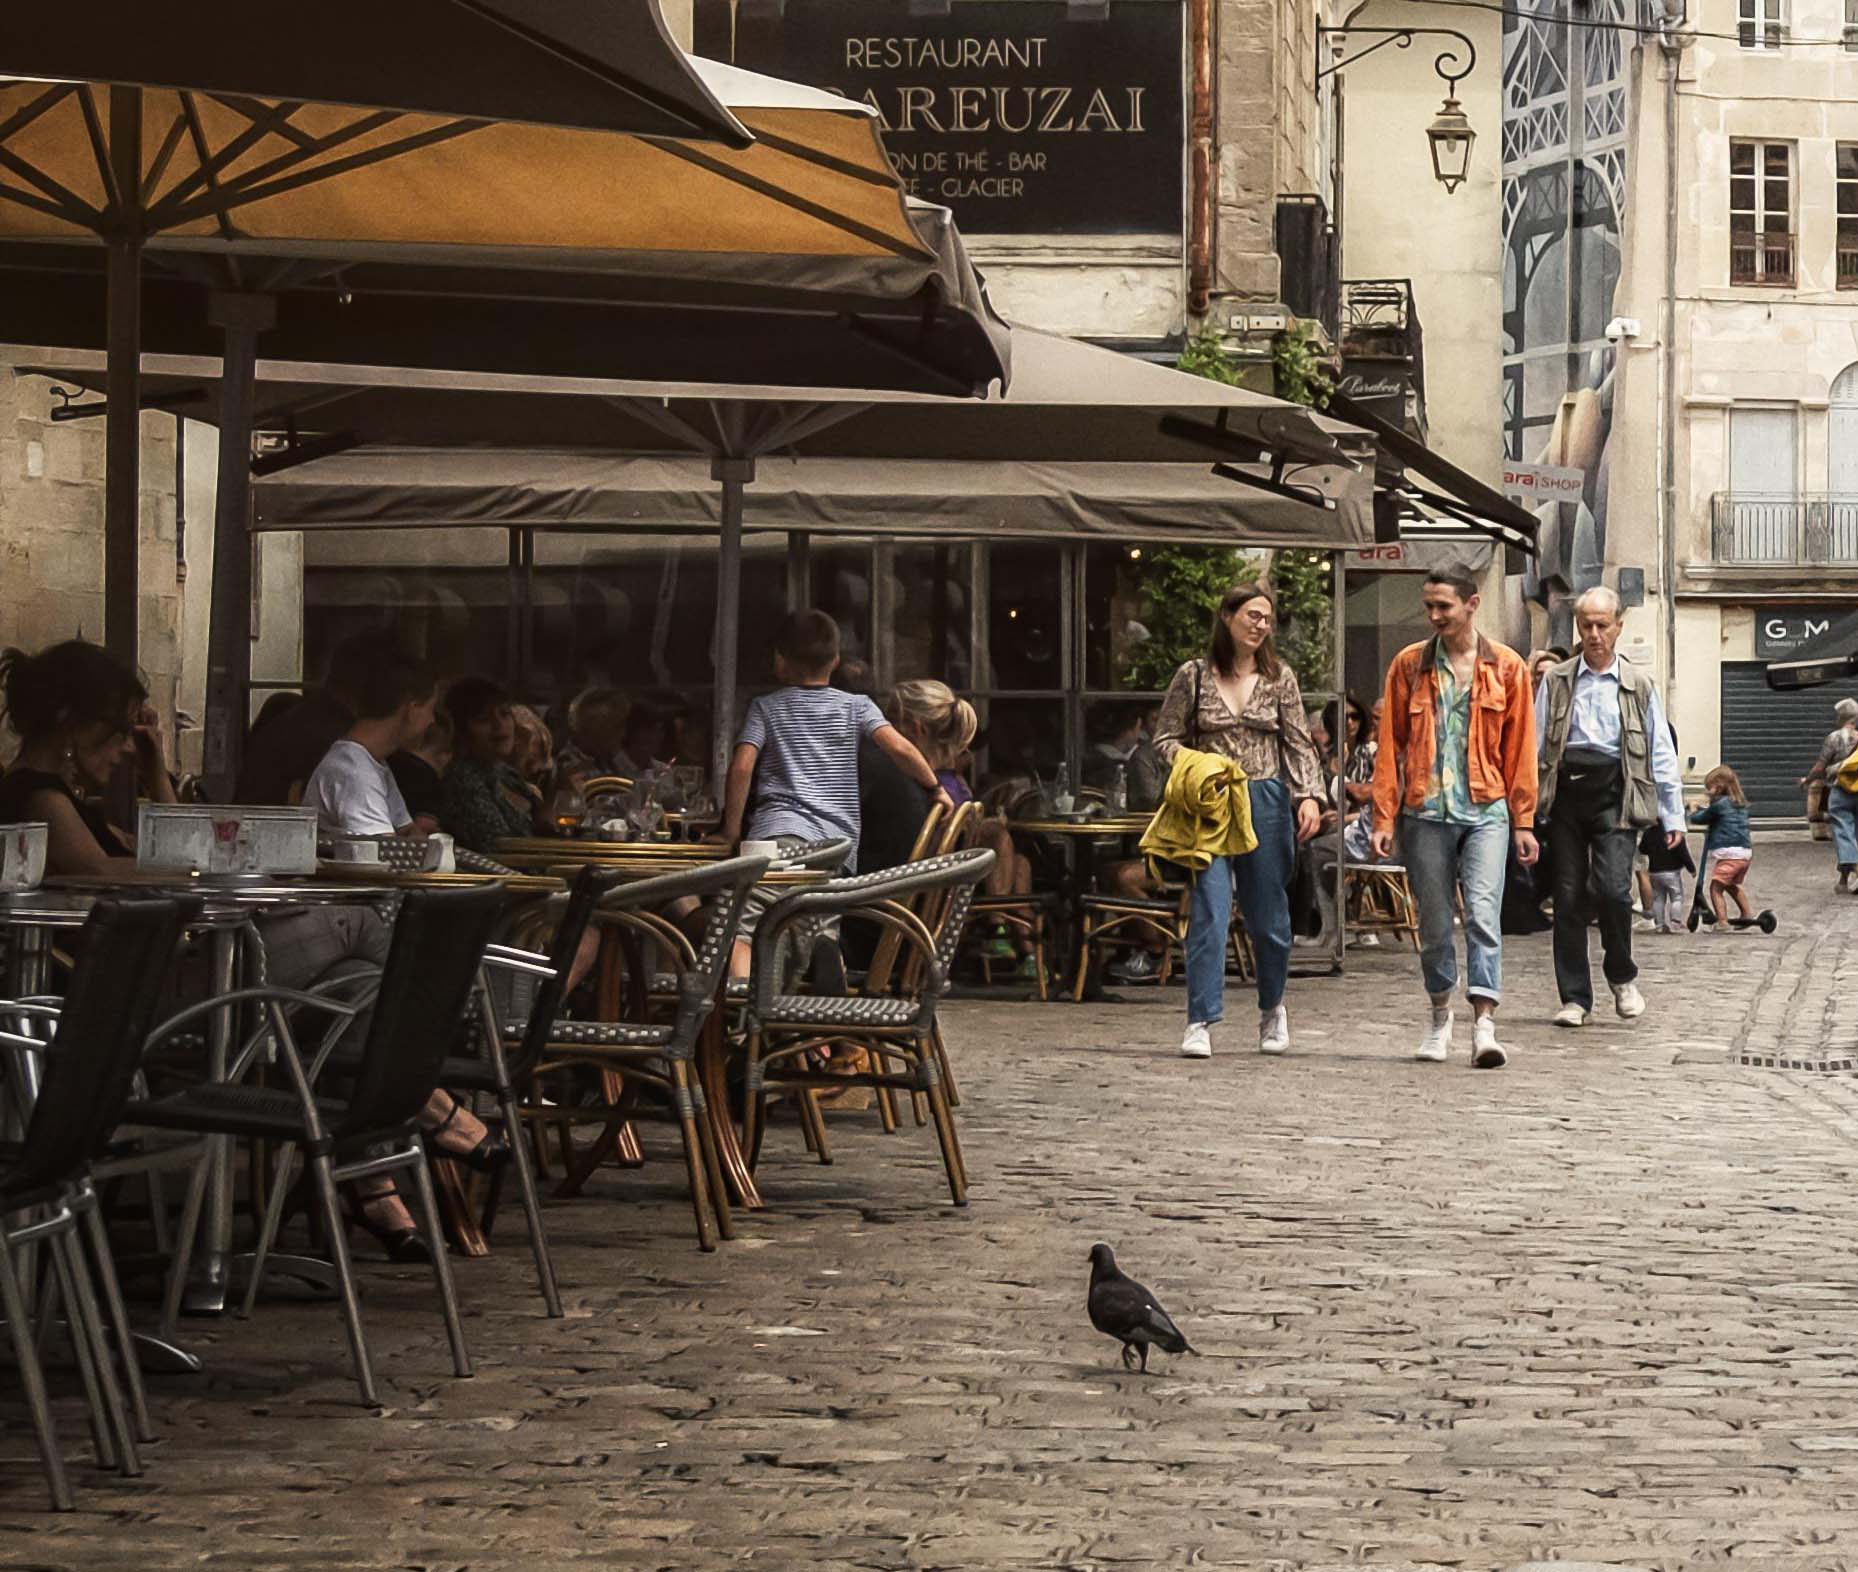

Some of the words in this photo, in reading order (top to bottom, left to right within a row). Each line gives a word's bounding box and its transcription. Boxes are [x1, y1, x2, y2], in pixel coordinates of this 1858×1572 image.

[845, 38, 1048, 68] RESTAURANT
[819, 86, 1147, 133] AREUZAI
[923, 152, 948, 172] DE
[1008, 152, 1048, 171] BAR
[940, 178, 1025, 198] GLACIER
[1541, 477, 1582, 490] SHOP
